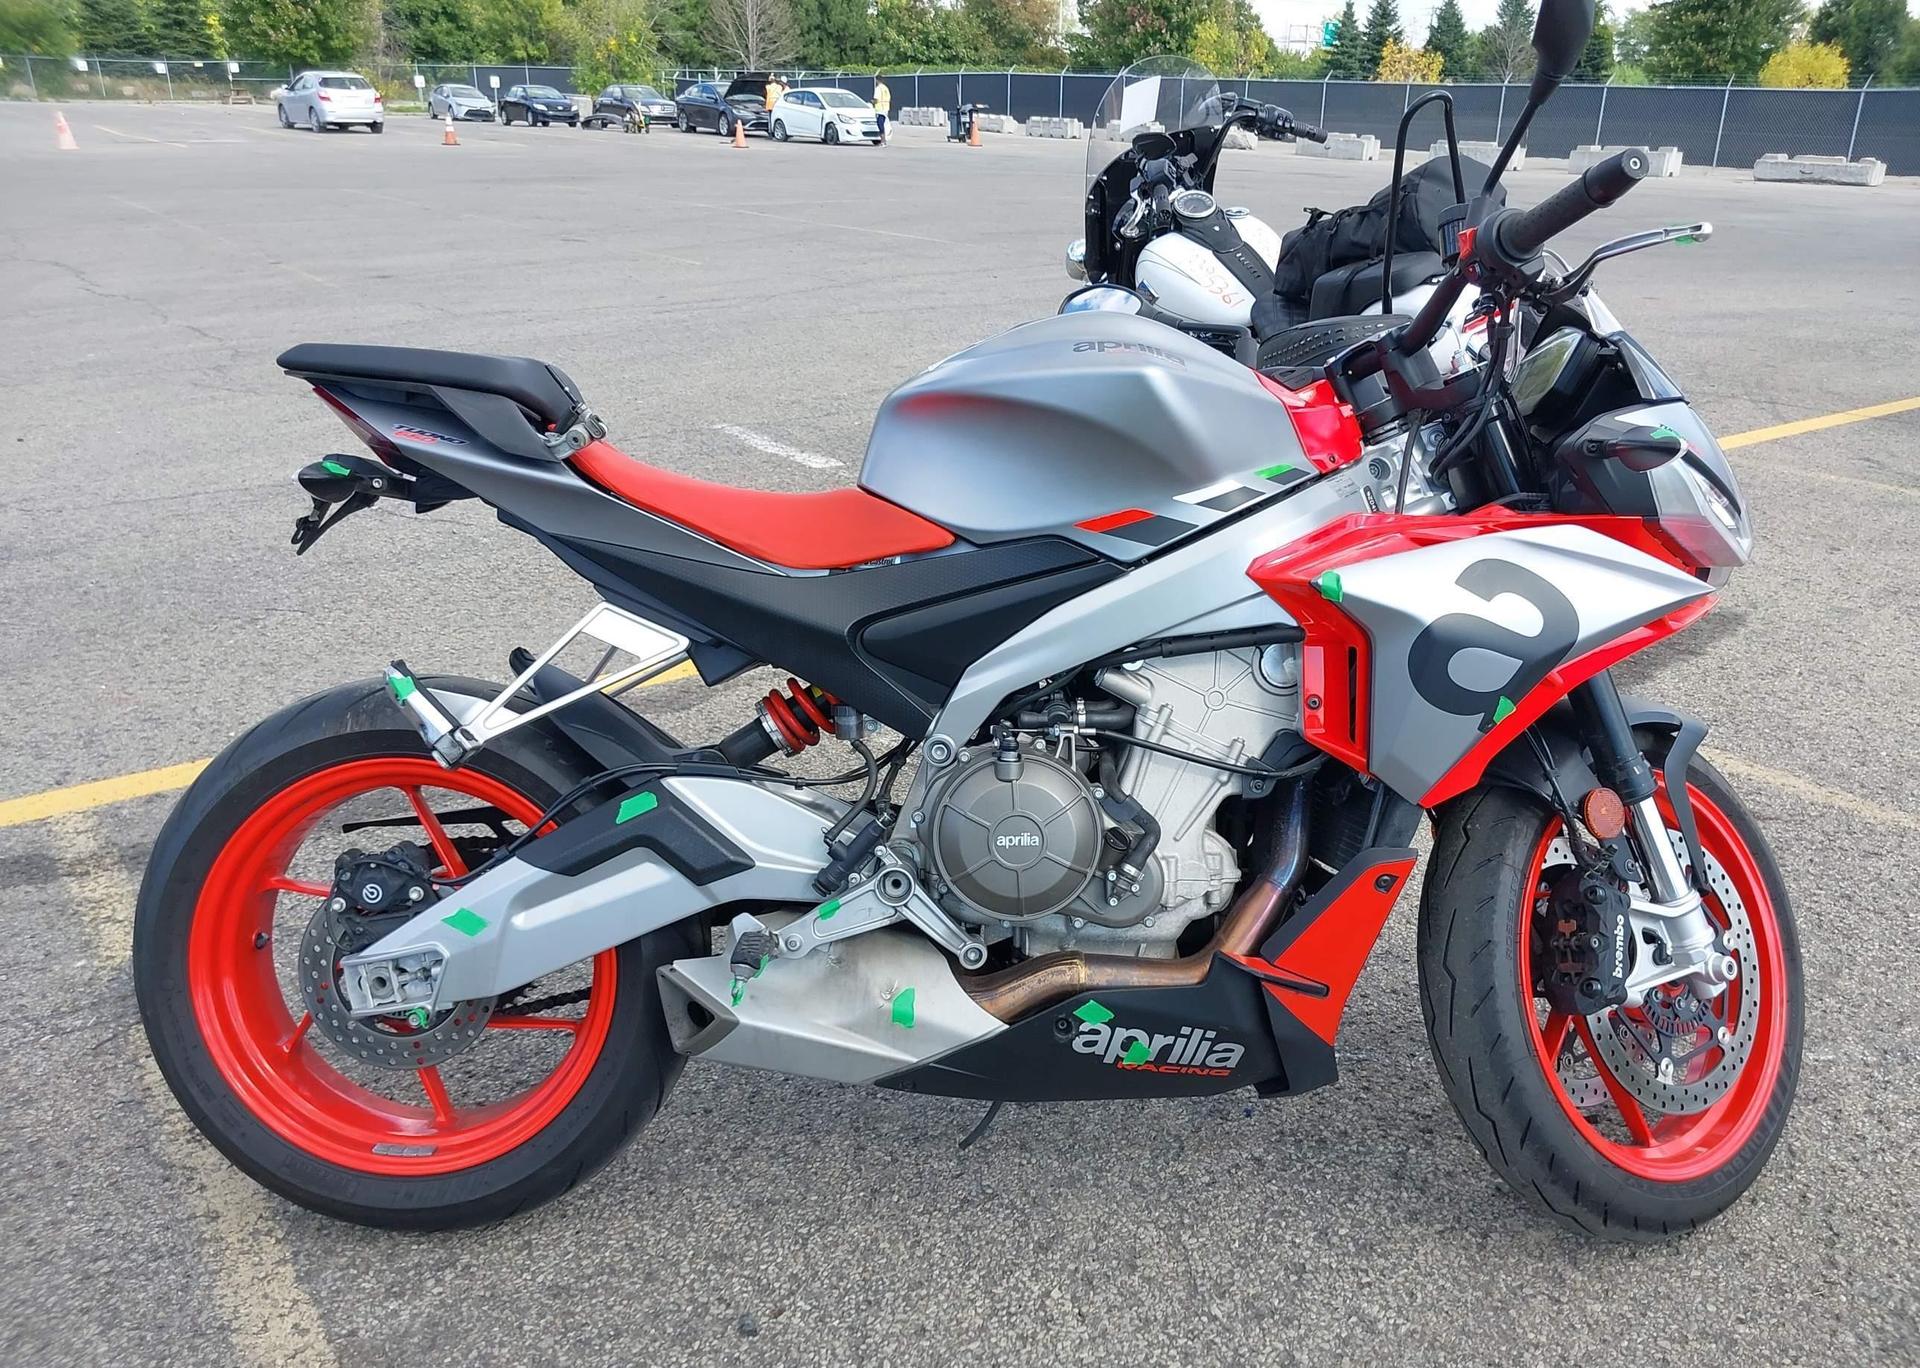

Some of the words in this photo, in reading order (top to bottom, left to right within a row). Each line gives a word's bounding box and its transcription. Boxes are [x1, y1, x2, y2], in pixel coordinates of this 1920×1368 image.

[1072, 340, 1186, 368] aprilia
[996, 832, 1040, 849] aprilia
[1612, 913, 1626, 979] brembo
[1071, 1021, 1246, 1069] aprilia
[1116, 1062, 1232, 1077] RACING
